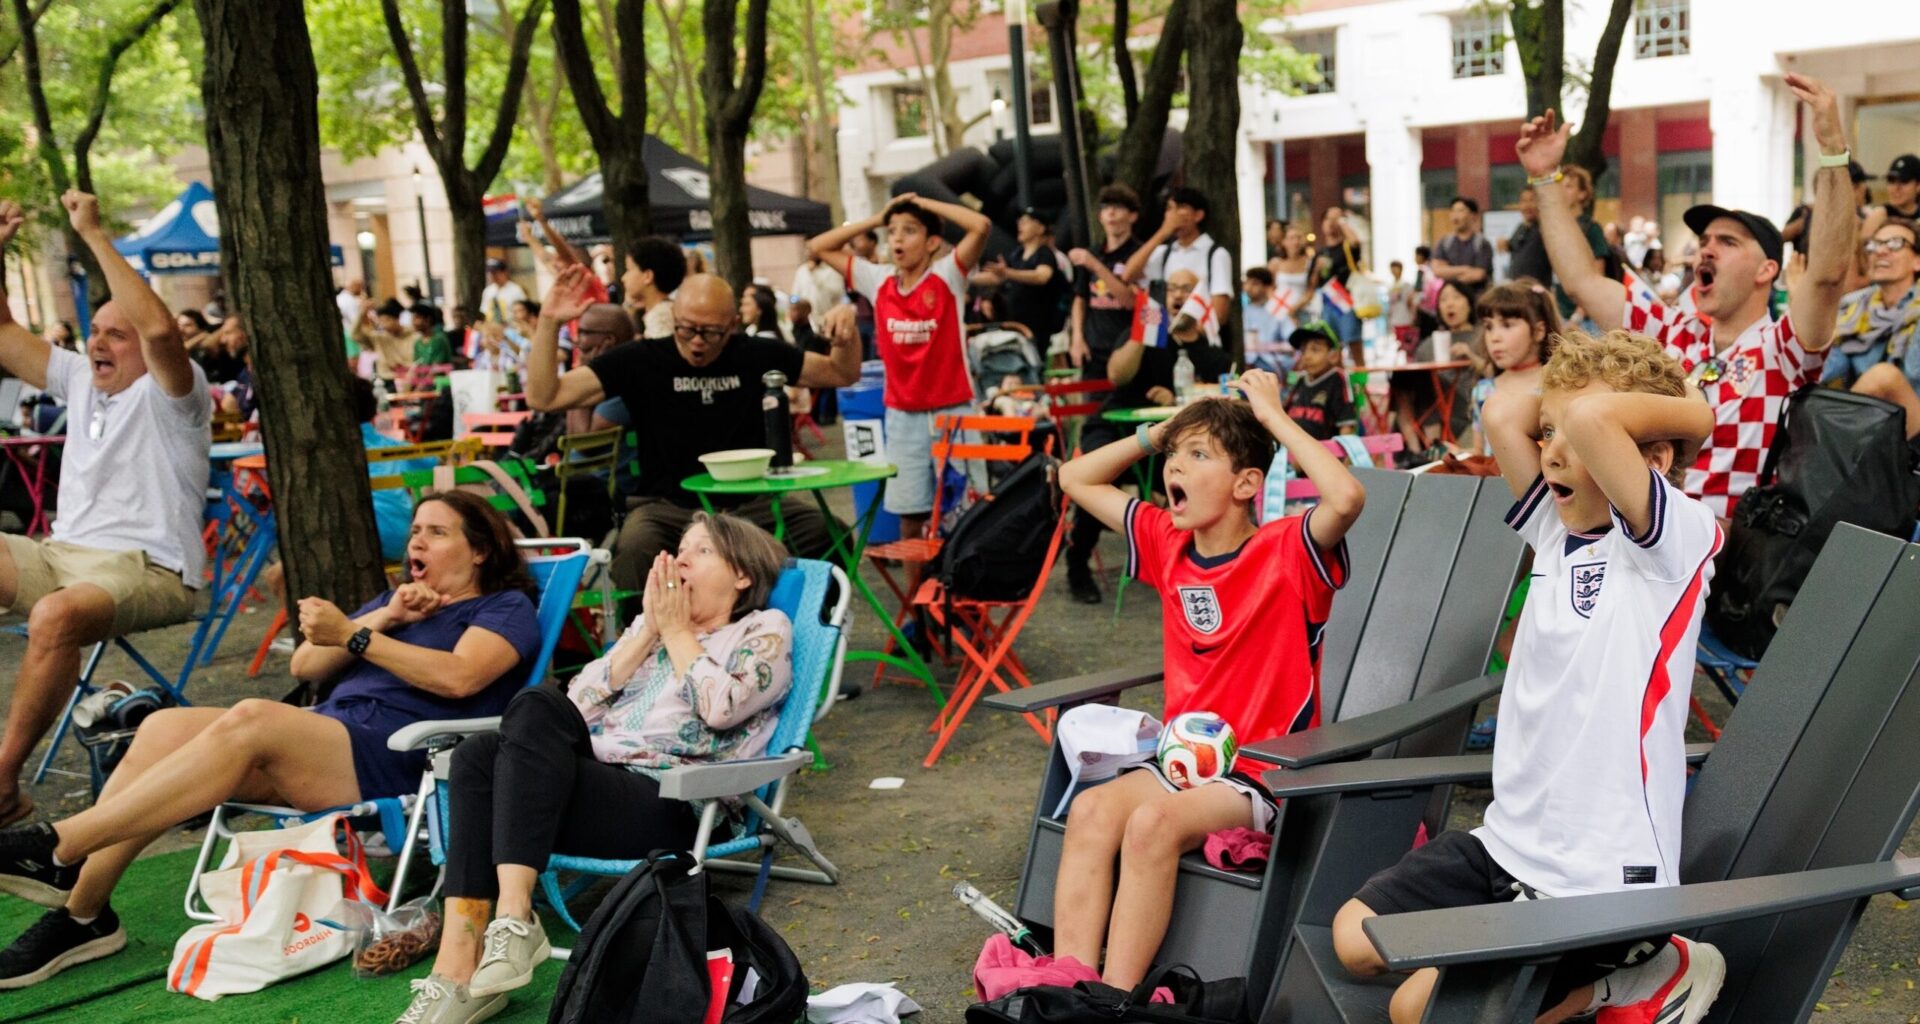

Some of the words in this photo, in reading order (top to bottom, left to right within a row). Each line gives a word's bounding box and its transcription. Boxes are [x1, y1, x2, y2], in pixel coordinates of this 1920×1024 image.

[887, 318, 938, 333] Emirates
[673, 374, 740, 392] BROOKLYN
[283, 929, 333, 957] DOORDASH
